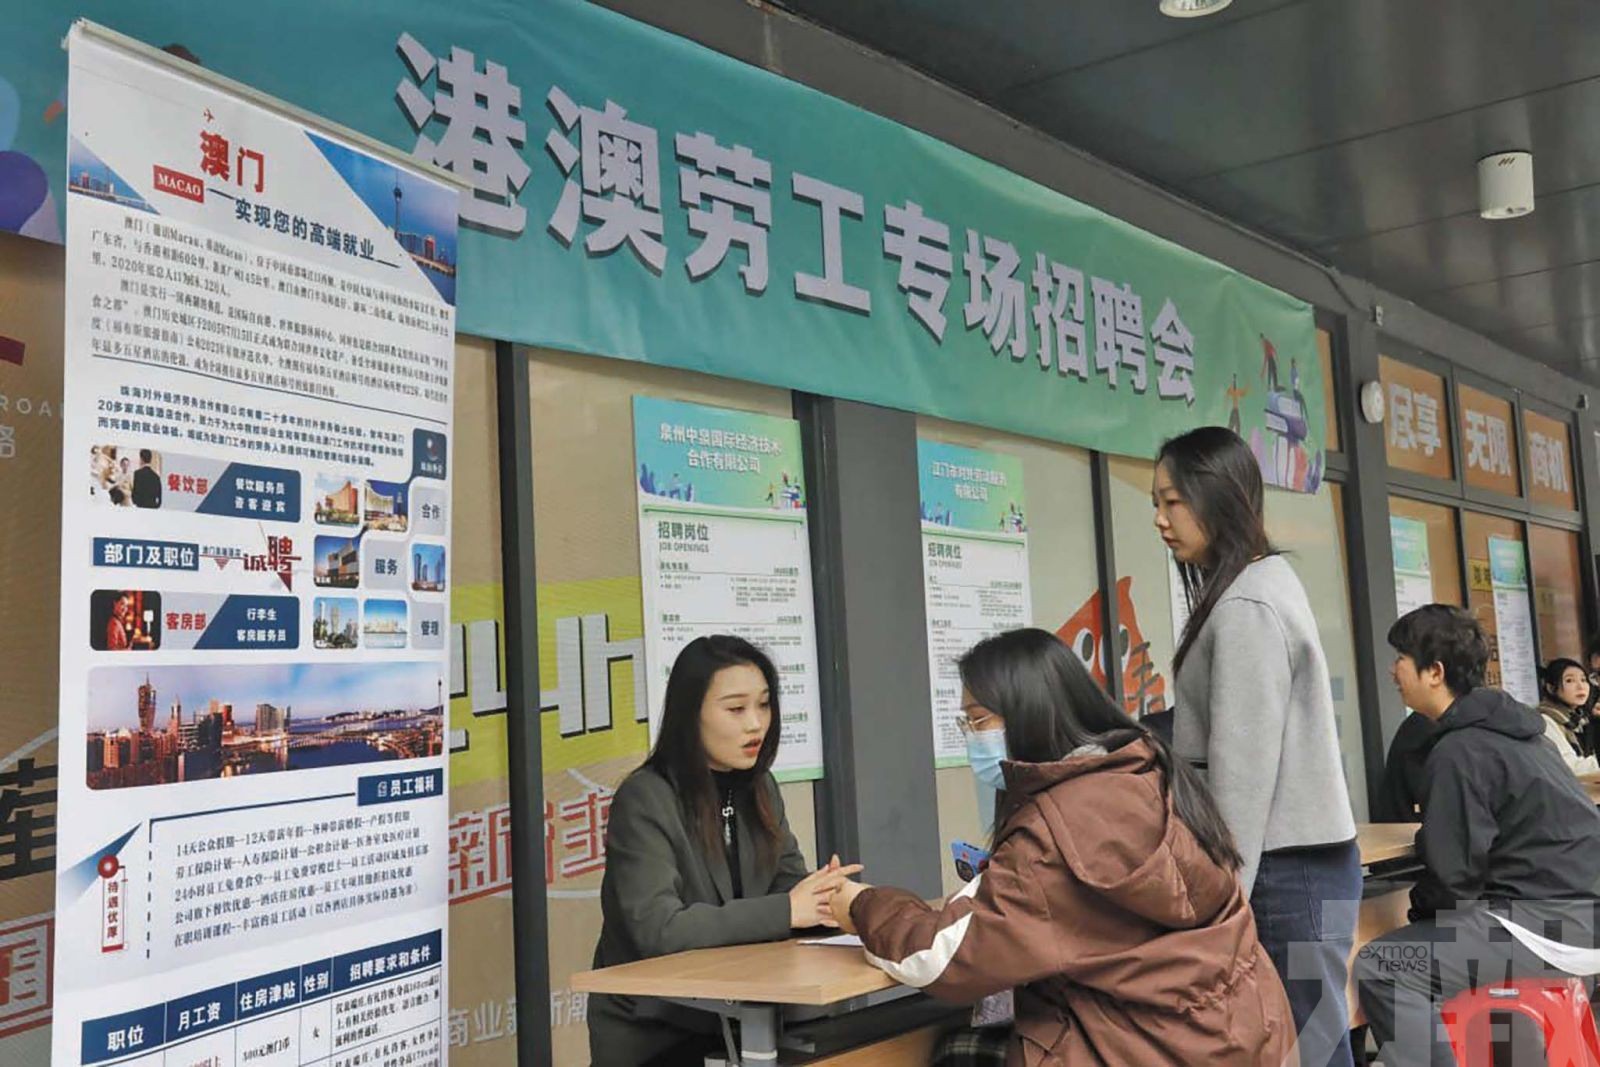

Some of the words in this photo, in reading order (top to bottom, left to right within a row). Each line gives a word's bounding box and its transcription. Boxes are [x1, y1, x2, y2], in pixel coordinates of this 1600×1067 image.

[200, 131, 265, 193] 澳门
[156, 173, 202, 198] MACAO
[235, 198, 375, 260] 实现您的高端就业
[395, 31, 1196, 406] 港澳劳工专场招聘会
[1465, 409, 1512, 477] 无限
[688, 449, 761, 474] 合作有限公司
[167, 473, 209, 496] 餐饮部
[235, 478, 286, 495] 餐饮服务员
[421, 503, 440, 520] 合作
[658, 520, 710, 541] 招聘岗位
[104, 543, 195, 568] 部门及职位
[243, 536, 294, 572] 诚聘
[375, 558, 398, 576] 服务
[166, 612, 207, 631] 客房部
[246, 608, 278, 622] 行李生
[237, 629, 287, 643] 客房服务员
[420, 620, 439, 637] 管理
[391, 775, 435, 797] 员工福利
[107, 880, 119, 939] 待遇优厚
[107, 1024, 145, 1052] 职位
[178, 1002, 222, 1032] 月工资
[240, 981, 296, 1012] 住房津贴
[304, 971, 330, 994] 性别
[350, 945, 431, 982] 招聘要求和条件
